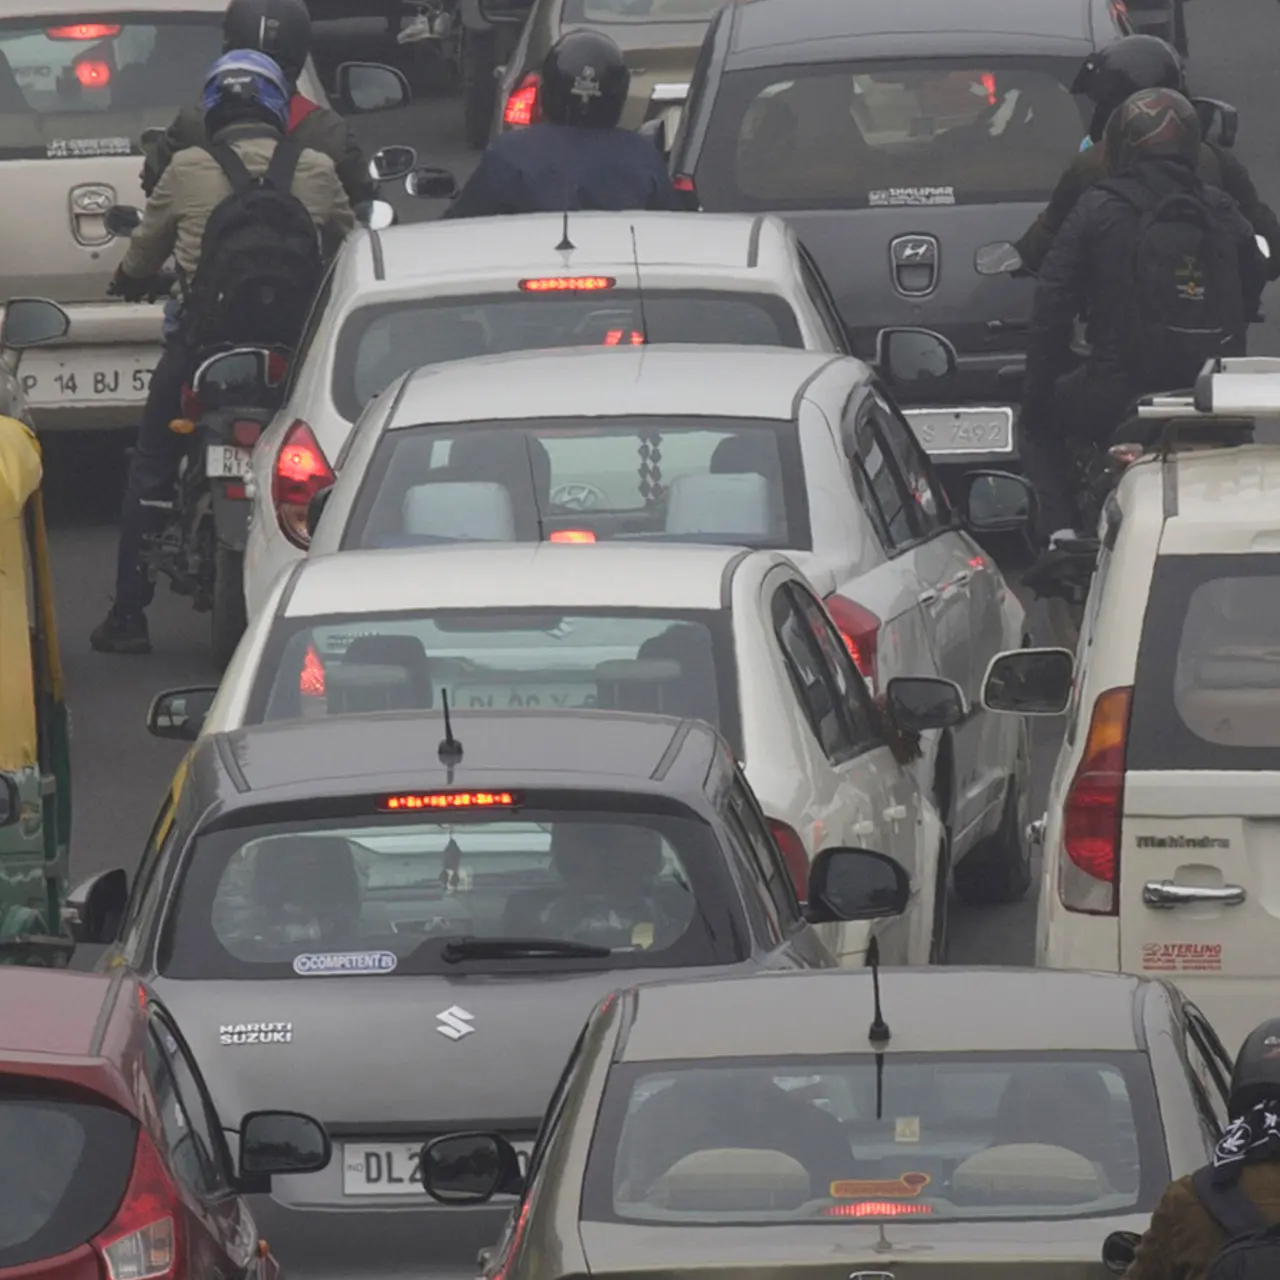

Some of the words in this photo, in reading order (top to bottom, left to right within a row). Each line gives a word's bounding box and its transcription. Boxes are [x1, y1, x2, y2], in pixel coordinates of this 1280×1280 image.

[54, 375, 78, 395] 14
[93, 374, 120, 395] BJ
[1135, 834, 1230, 850] Mahindra
[1163, 942, 1223, 958] STERLING
[310, 953, 382, 972] COMPETENT
[220, 1022, 293, 1034] MARUTI
[220, 1032, 292, 1046] SUZUKI
